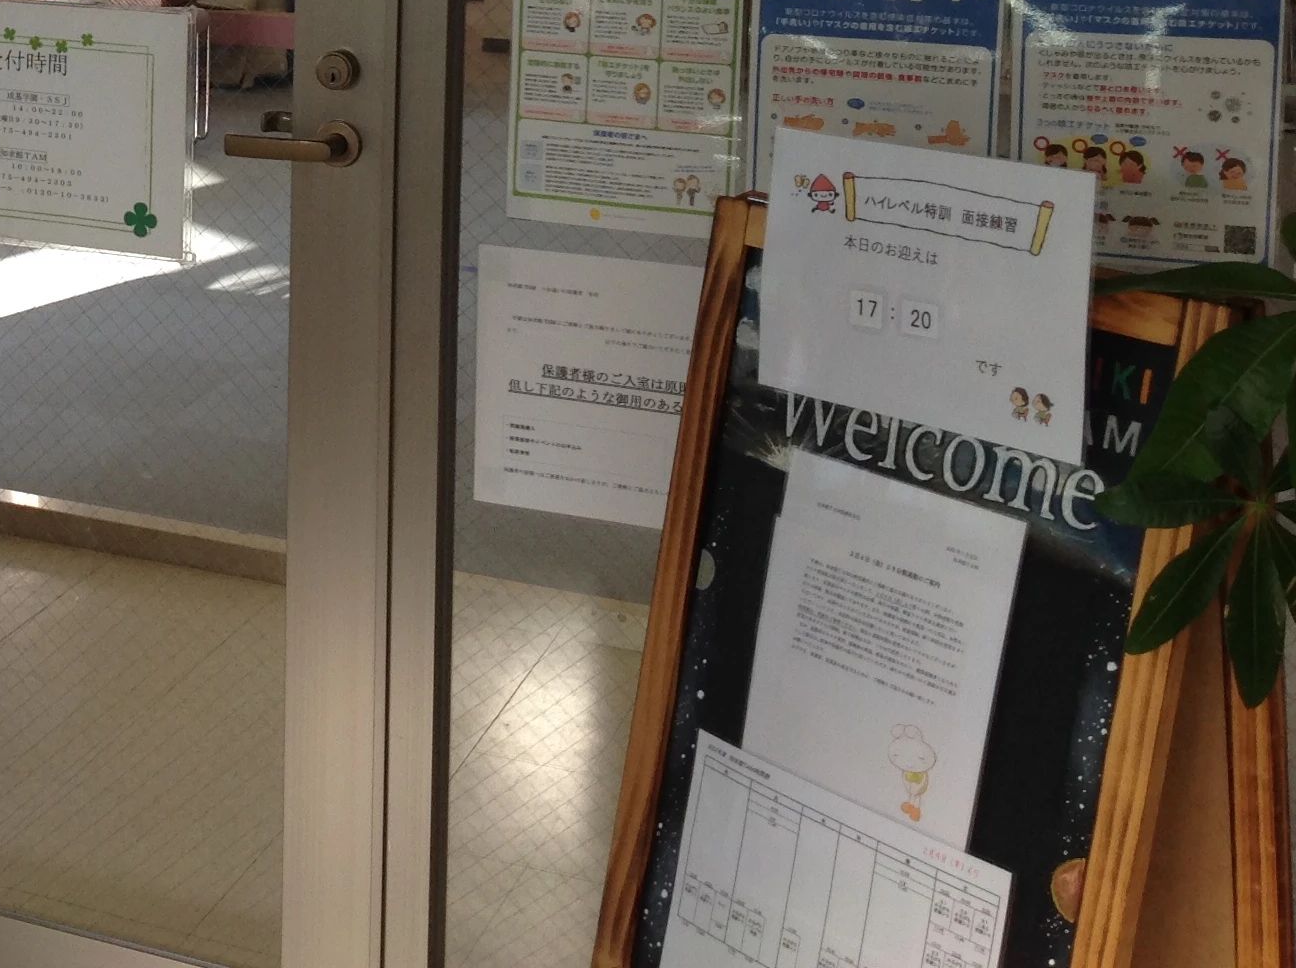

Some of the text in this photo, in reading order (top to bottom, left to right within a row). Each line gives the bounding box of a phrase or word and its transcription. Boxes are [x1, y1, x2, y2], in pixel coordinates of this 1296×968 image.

[864, 194, 1019, 234] ハイレベル特訓 面接練習
[843, 233, 939, 266] 本日のお迎えは
[856, 297, 879, 319] 17
[910, 309, 933, 330] 20
[975, 358, 1003, 377] です
